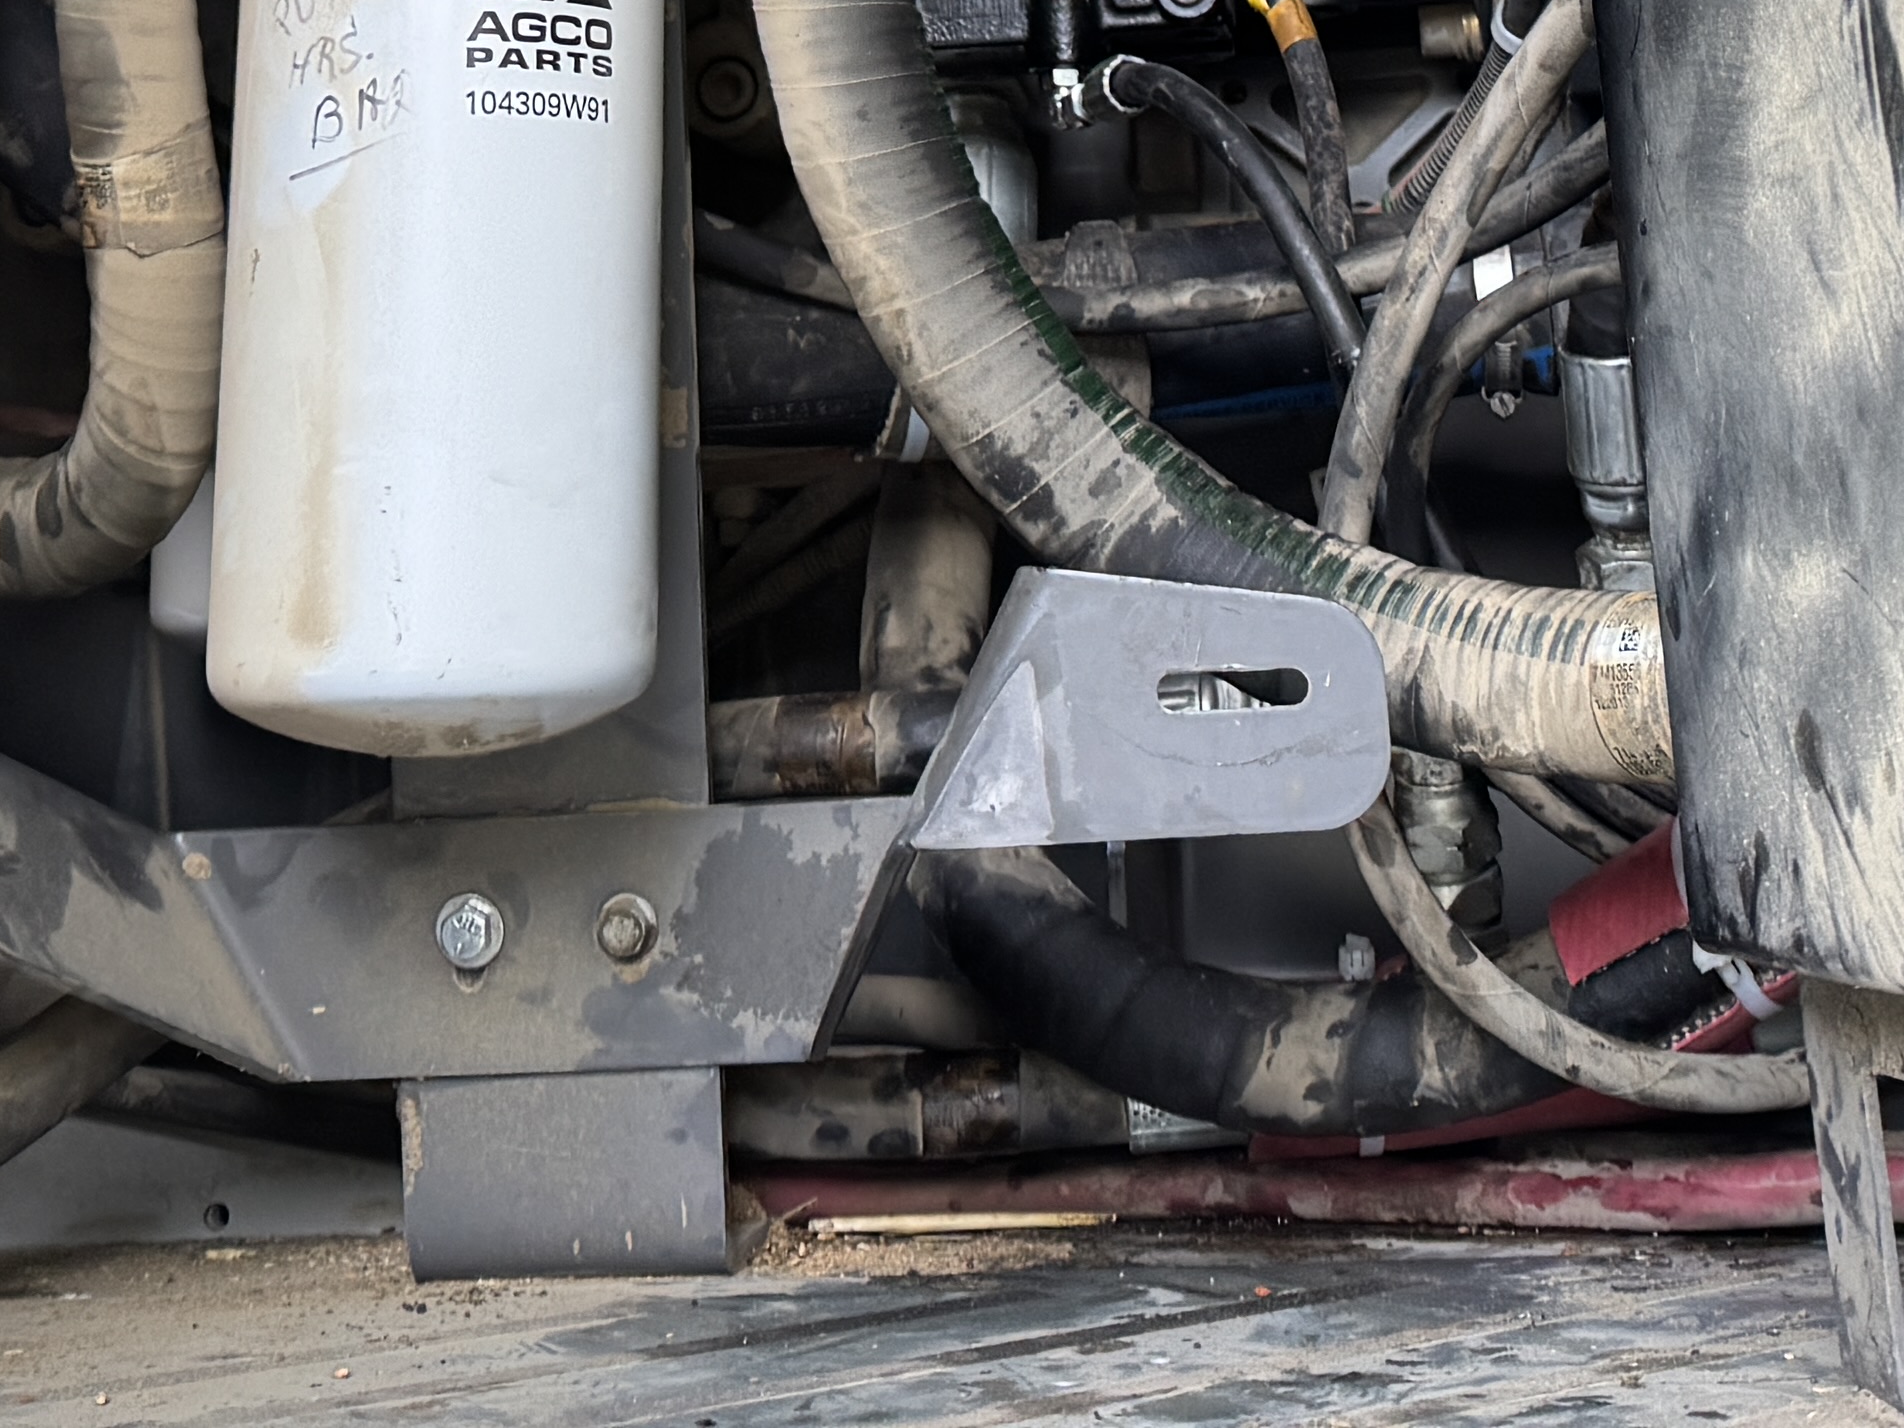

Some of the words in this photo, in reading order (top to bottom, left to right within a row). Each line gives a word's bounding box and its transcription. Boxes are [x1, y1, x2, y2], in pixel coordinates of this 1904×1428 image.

[466, 10, 613, 51] AGCO
[466, 47, 613, 78] PARTS
[466, 90, 609, 124] 104309W91
